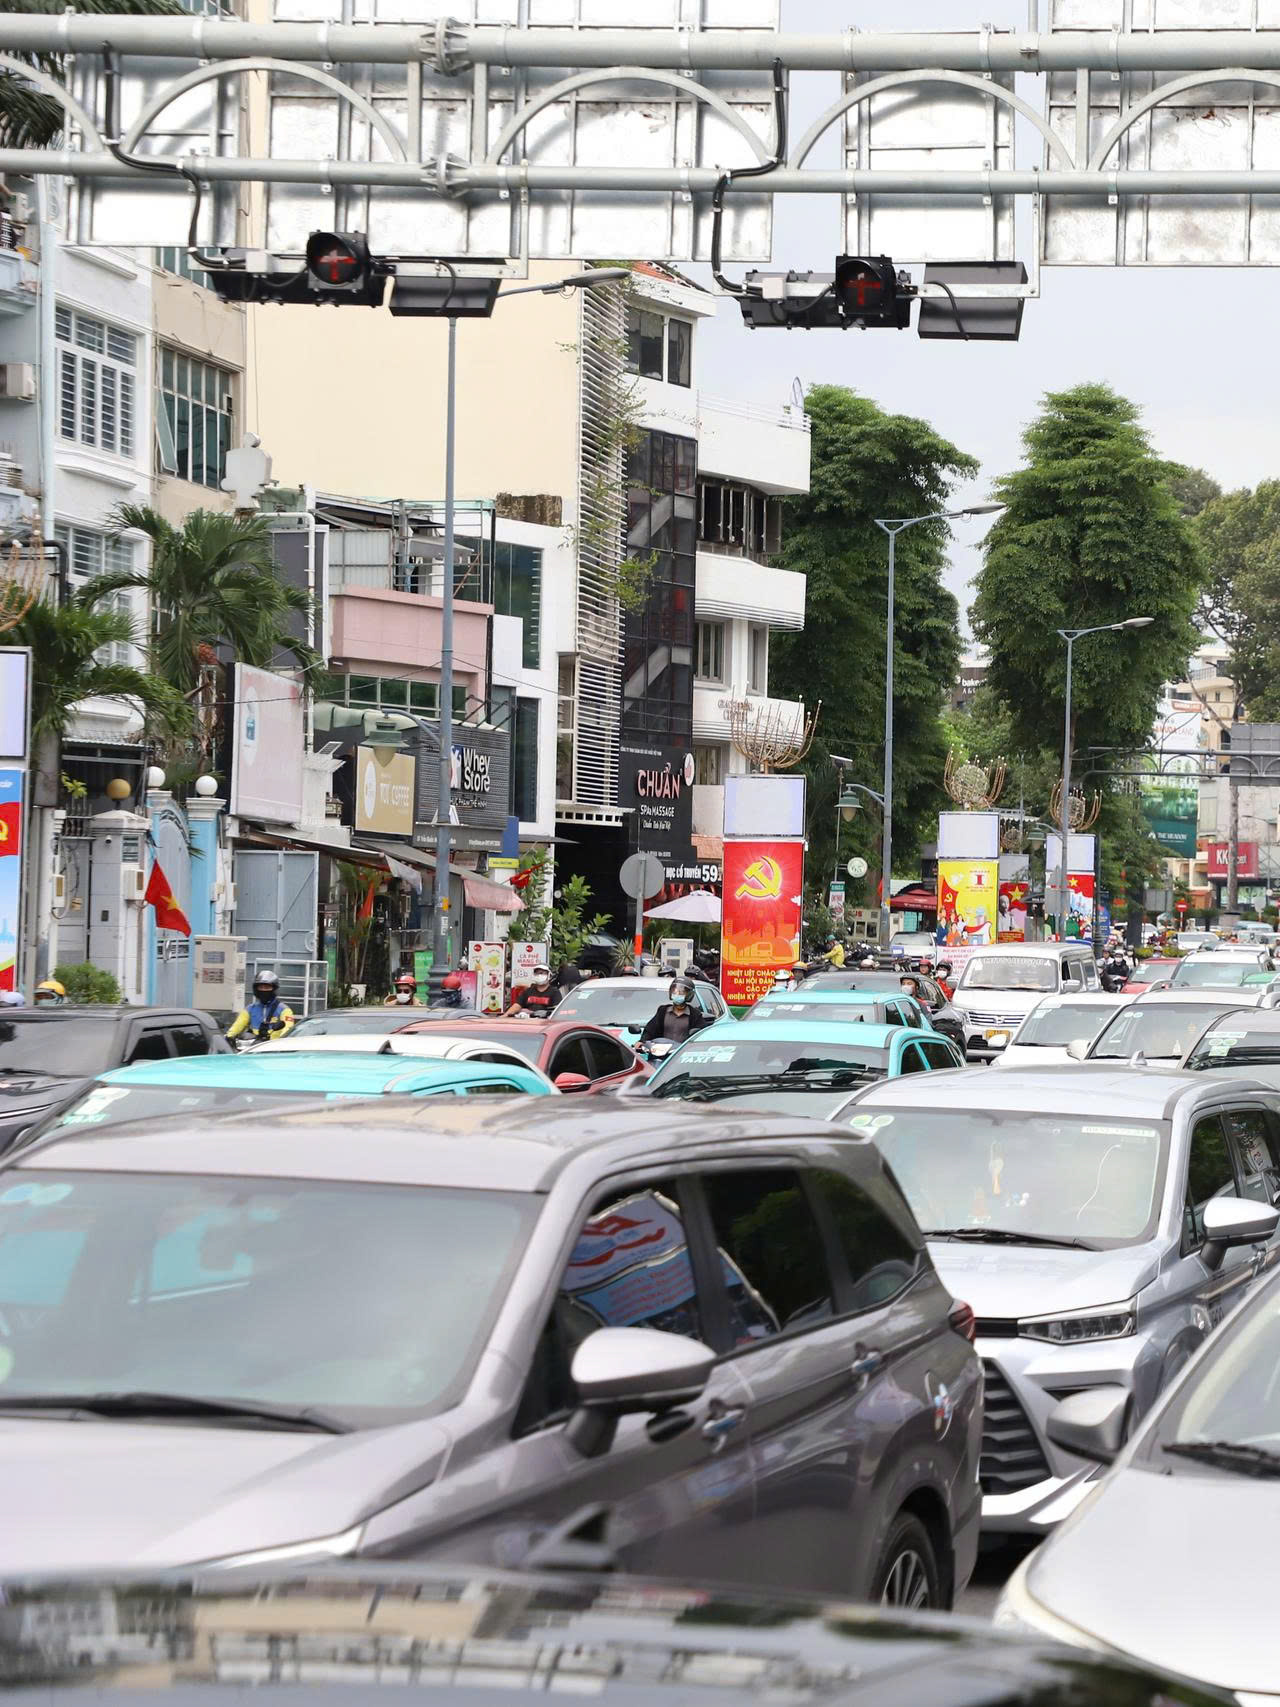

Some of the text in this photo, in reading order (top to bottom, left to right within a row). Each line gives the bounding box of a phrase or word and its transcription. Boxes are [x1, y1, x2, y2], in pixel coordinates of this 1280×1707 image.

[463, 748, 491, 773] Whey
[464, 767, 490, 792] Store
[638, 762, 680, 799] CHUẨN
[727, 969, 743, 978] NHIỆT
[756, 969, 776, 977] CHÀO
[734, 978, 745, 986] ĐẠI
[746, 984, 761, 992] CÁC
[727, 992, 746, 1001] NHIỆM
